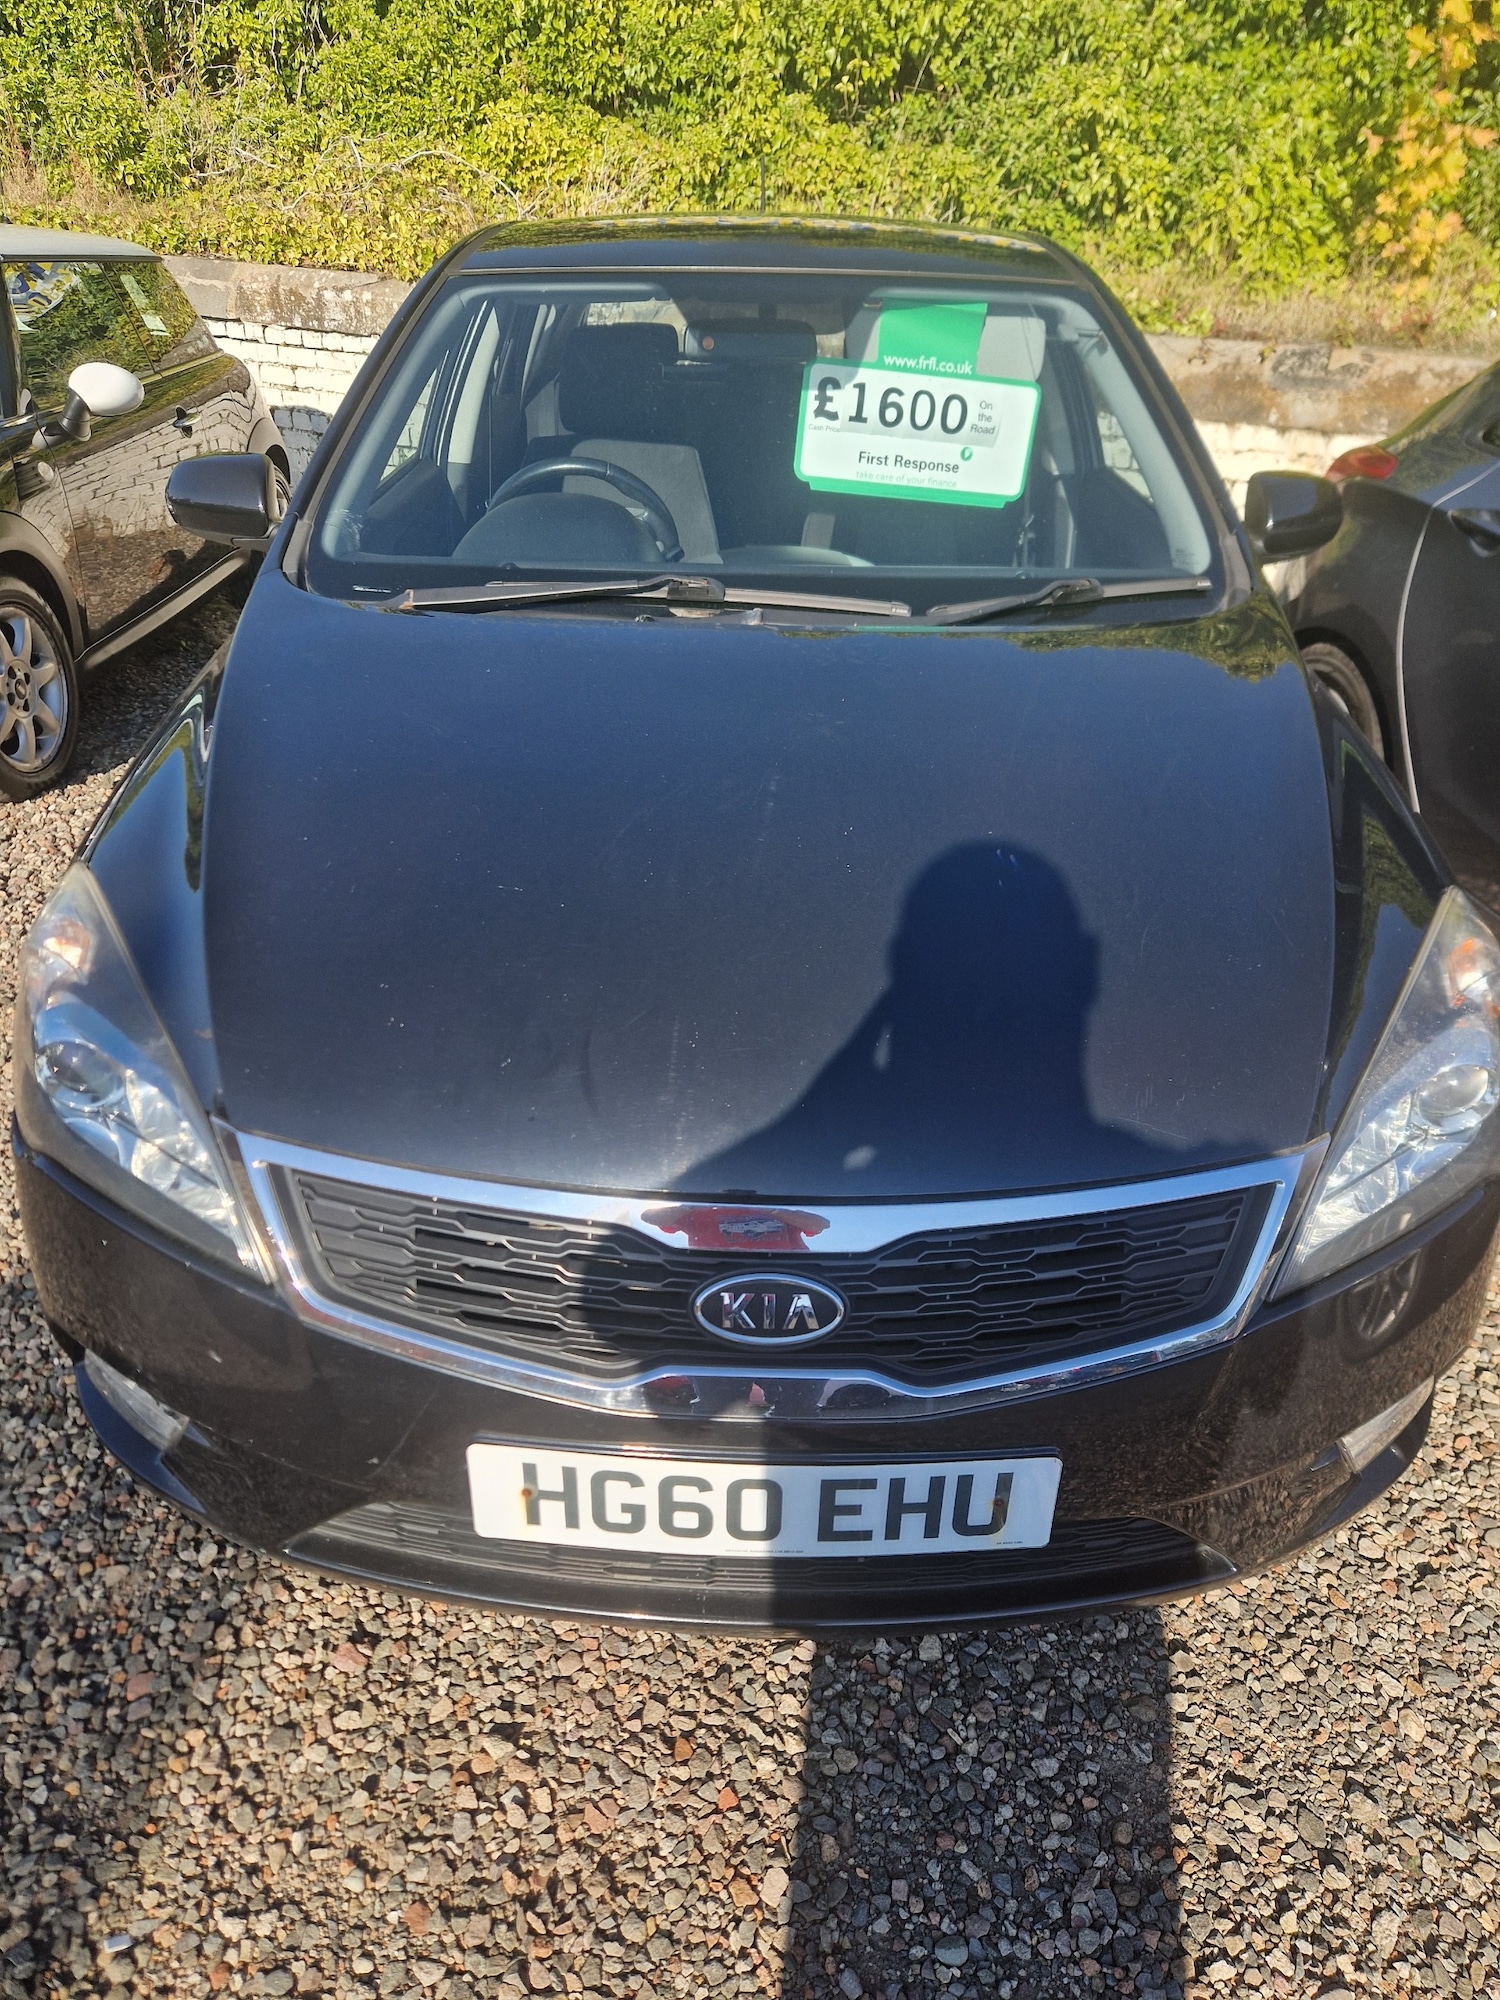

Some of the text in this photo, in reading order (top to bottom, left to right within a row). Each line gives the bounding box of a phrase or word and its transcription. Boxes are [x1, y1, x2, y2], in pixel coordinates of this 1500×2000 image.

[883, 355, 974, 375] www.frfl.co.uk
[813, 376, 968, 434] £1600
[979, 400, 993, 410] On
[977, 412, 993, 422] the
[970, 423, 996, 434] Road
[858, 451, 960, 474] First Response
[856, 471, 958, 488] take care of your finance
[719, 1292, 820, 1330] KIA
[521, 1462, 1014, 1542] HG60 EHU
